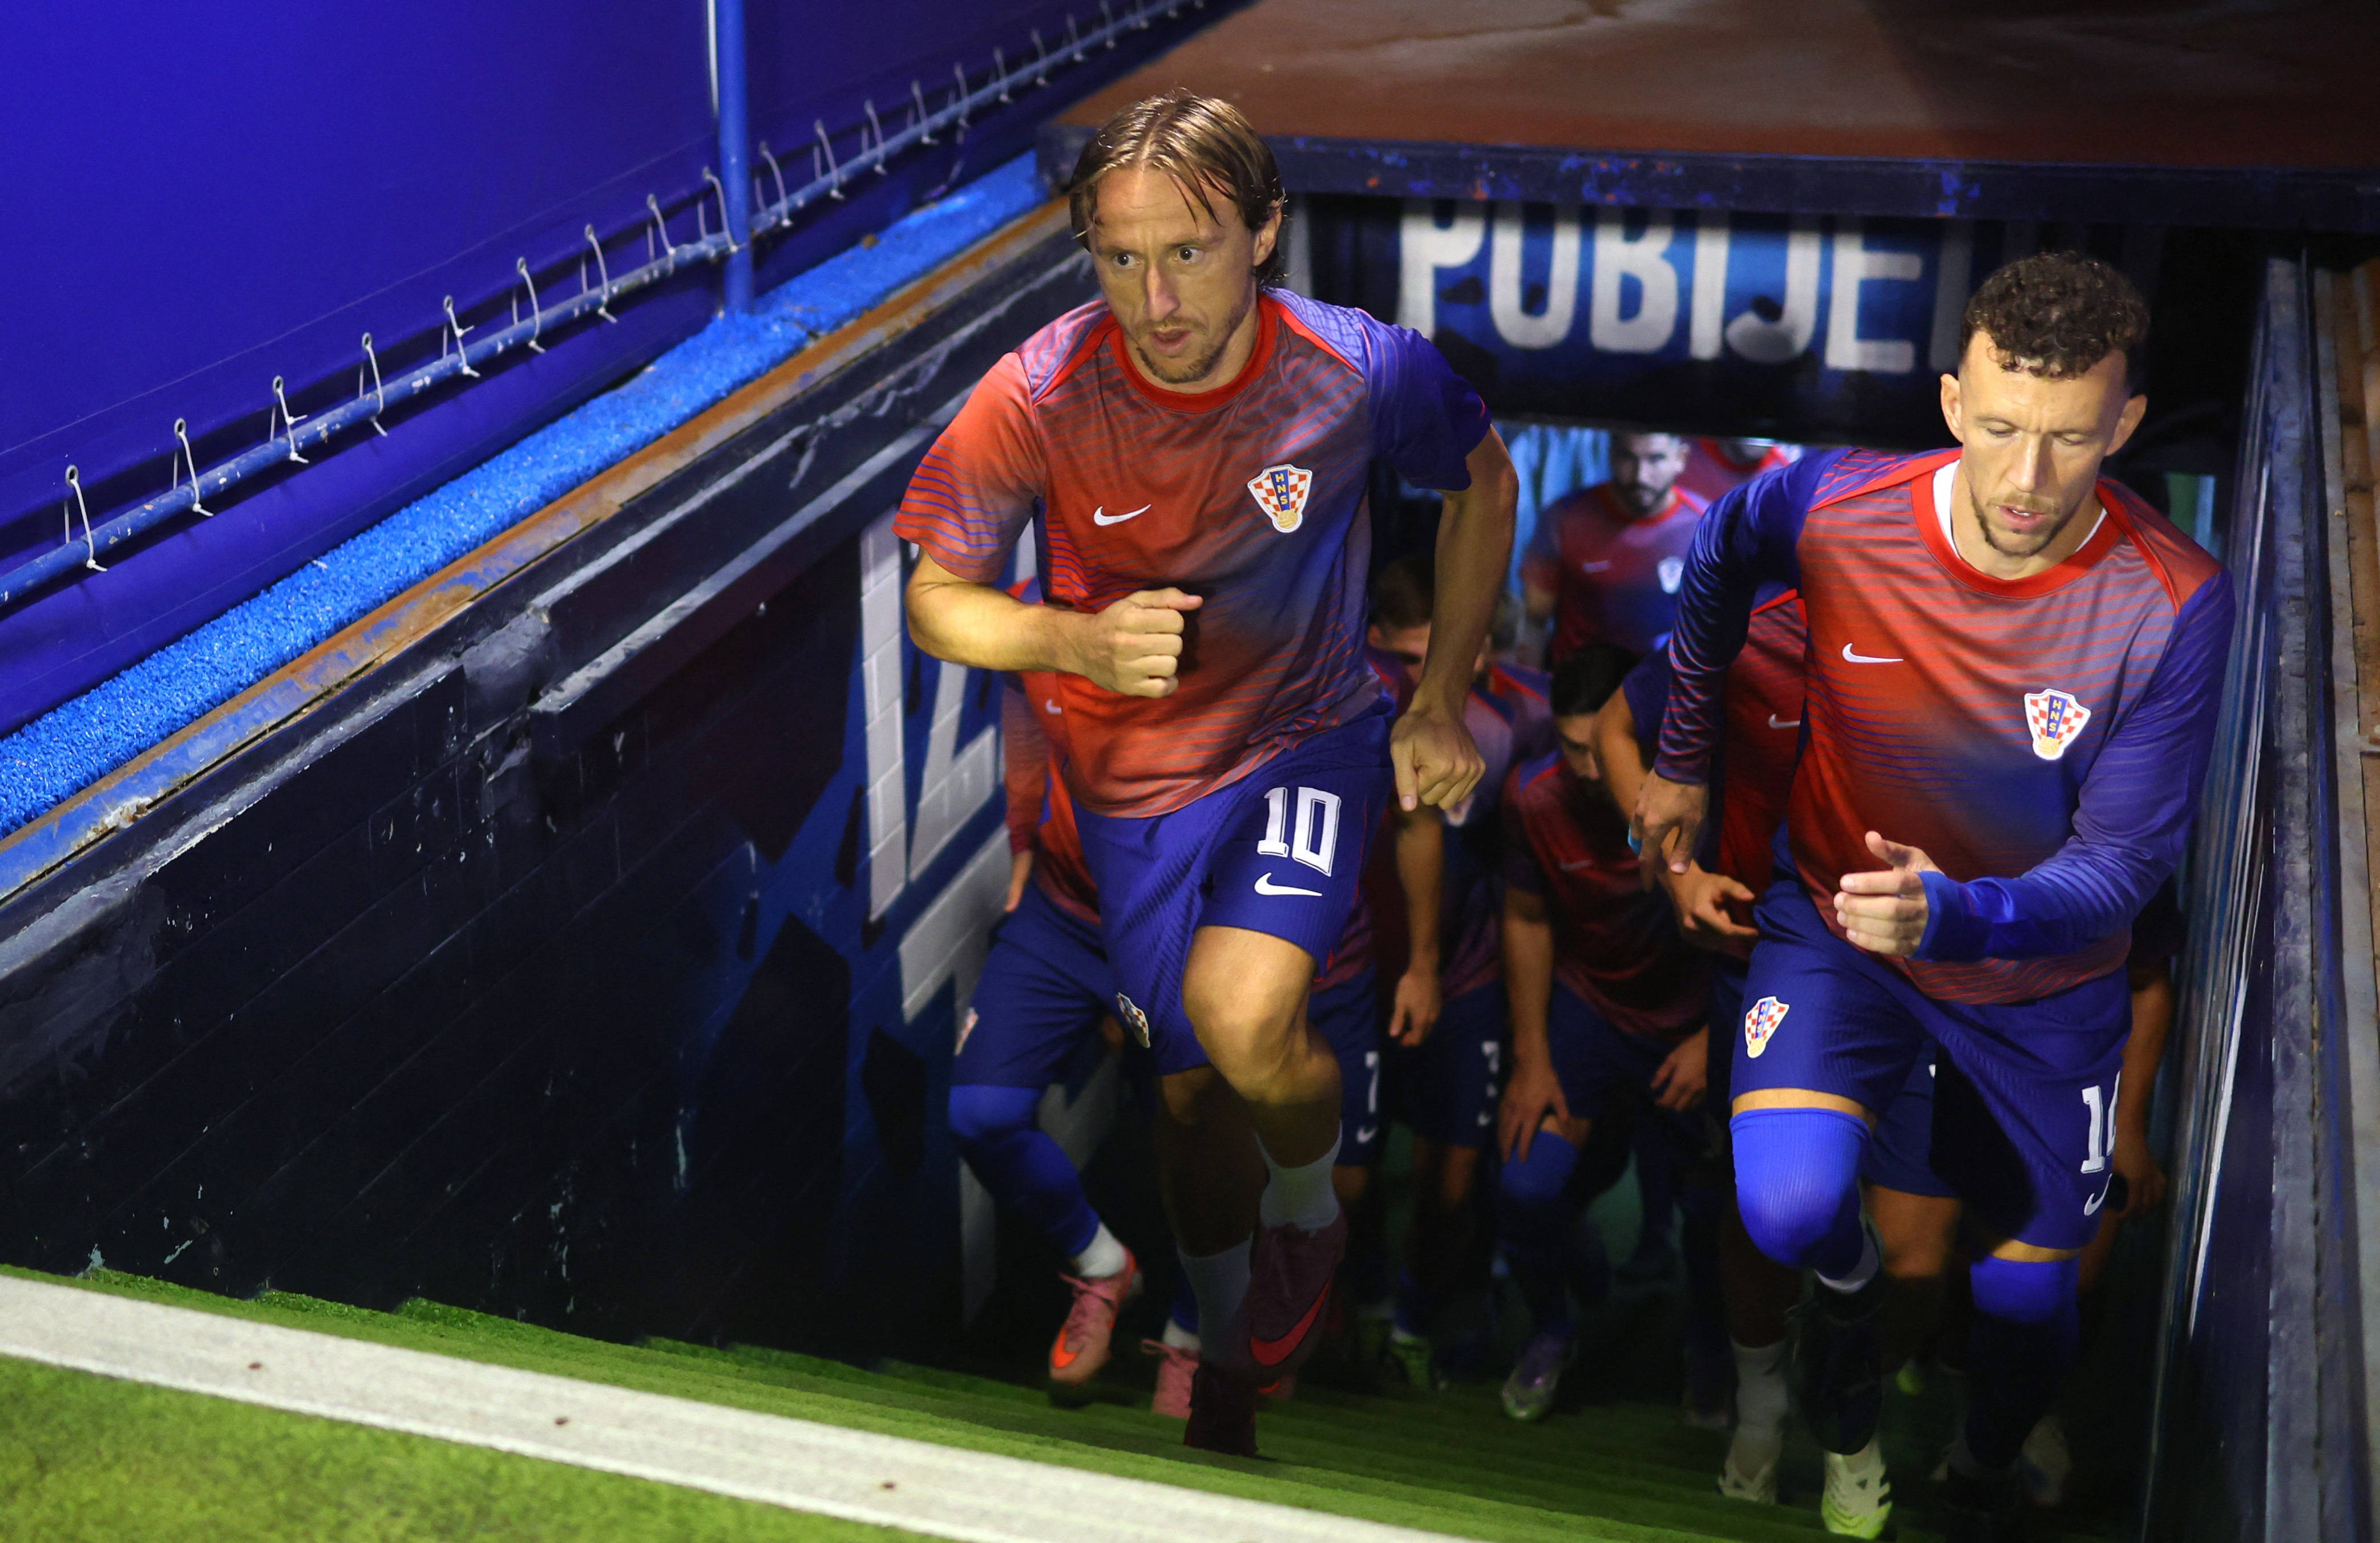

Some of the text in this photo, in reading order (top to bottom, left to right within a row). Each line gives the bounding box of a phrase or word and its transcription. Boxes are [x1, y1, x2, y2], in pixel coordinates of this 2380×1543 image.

[1275, 473, 1288, 505] HNS
[2048, 699, 2062, 732] HNS
[1256, 787, 1341, 877] 10
